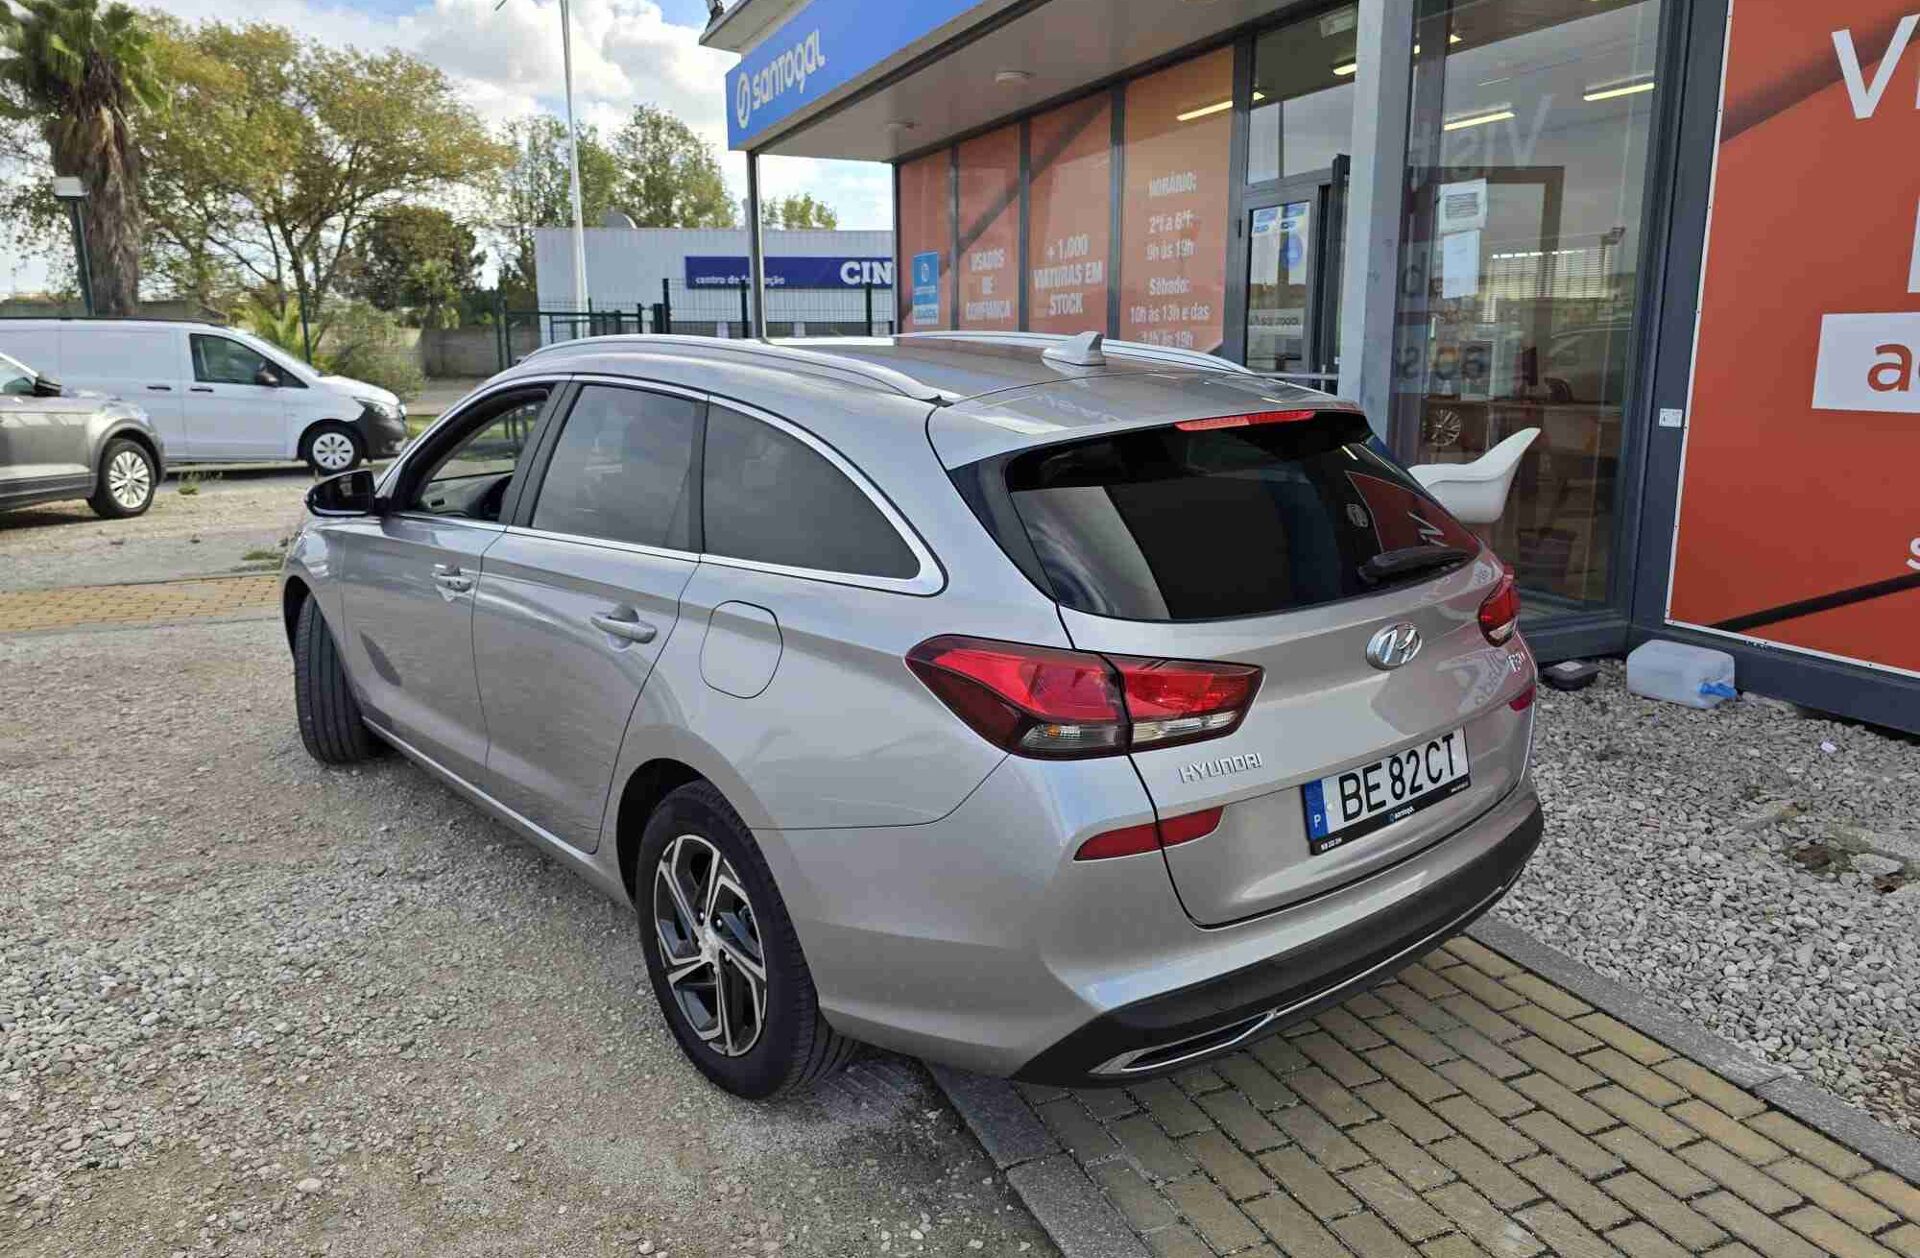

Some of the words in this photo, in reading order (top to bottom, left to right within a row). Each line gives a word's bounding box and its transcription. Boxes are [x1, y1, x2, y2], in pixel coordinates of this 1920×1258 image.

[752, 28, 825, 110] santogal
[1831, 13, 1920, 119] V
[1175, 238, 1195, 258] 19h
[695, 275, 725, 285] centro
[728, 274, 740, 285] de
[1033, 264, 1082, 290] VIATURAS
[1085, 260, 1103, 284] EM
[1049, 292, 1083, 316] STOCK
[1191, 301, 1210, 321] das
[1866, 342, 1920, 393] a
[1177, 753, 1262, 784] HYUNDAI
[1313, 814, 1322, 829] P
